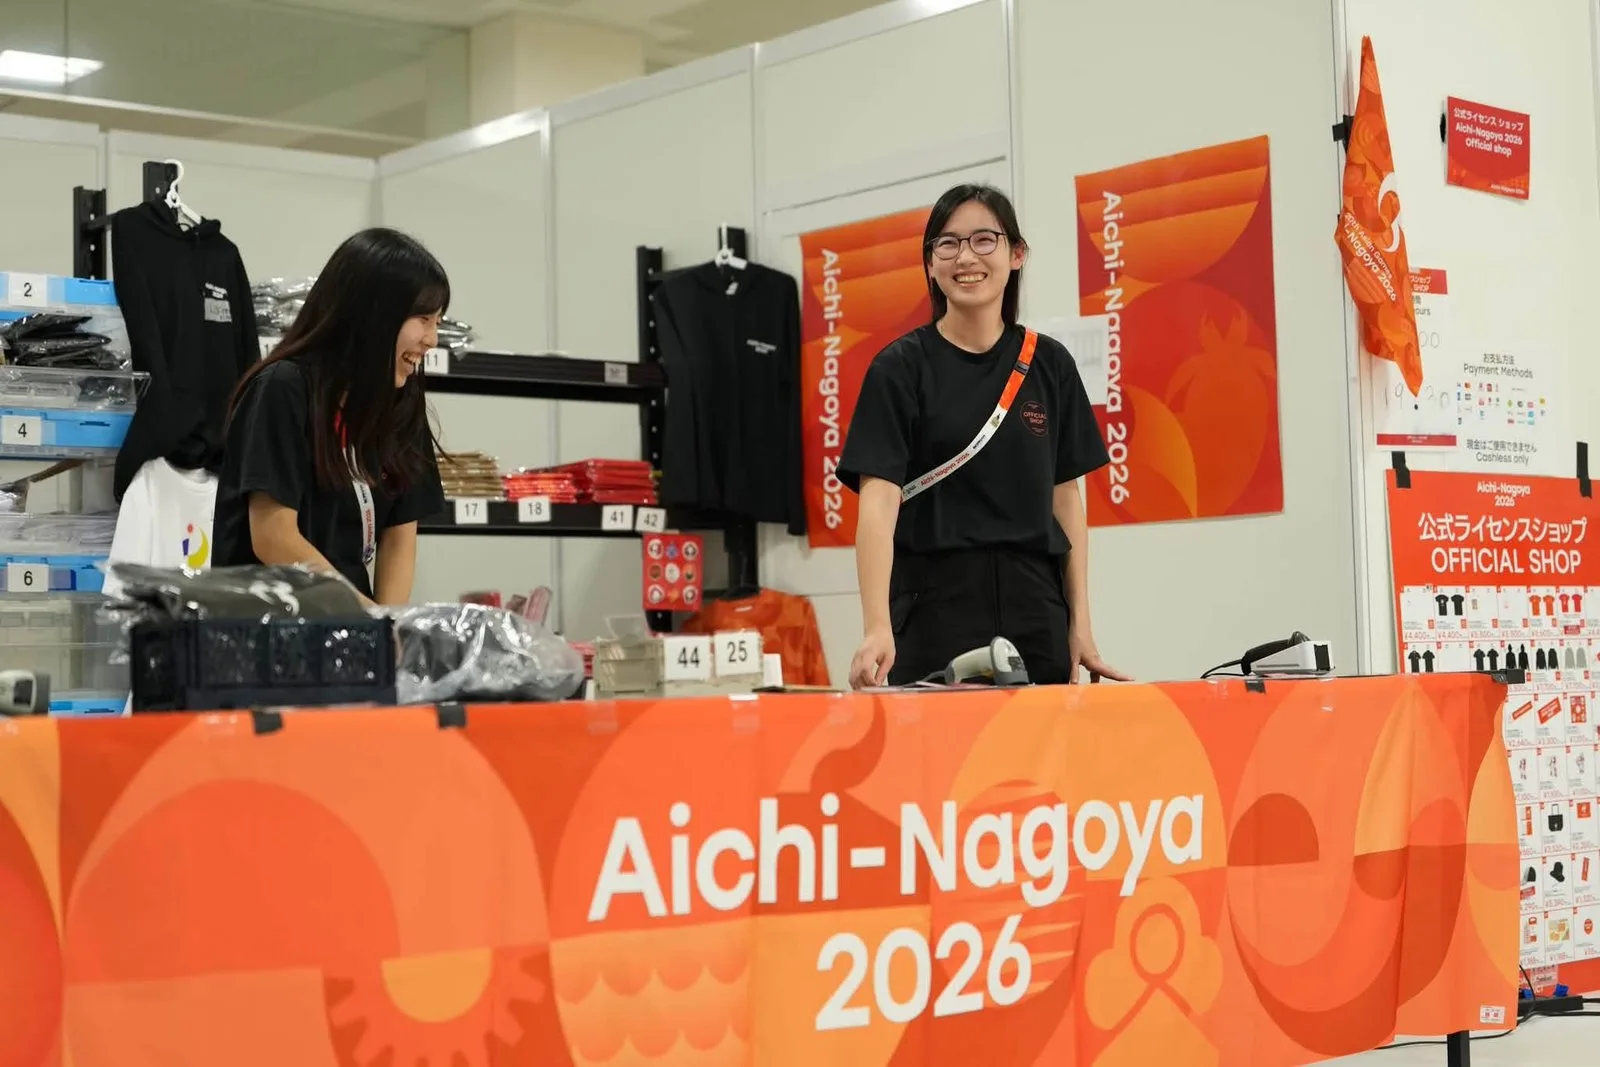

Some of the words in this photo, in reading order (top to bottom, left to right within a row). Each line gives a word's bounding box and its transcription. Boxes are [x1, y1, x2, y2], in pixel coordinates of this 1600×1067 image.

[1456, 122, 1503, 144] Aichi-Nagoya
[1504, 133, 1523, 145] 2026
[1465, 138, 1492, 151] Official
[1494, 144, 1512, 158] shop
[1359, 231, 1375, 252] Asian
[1374, 251, 1393, 280] Games
[23, 282, 32, 297] 2
[1377, 272, 1397, 301] 2026
[1102, 191, 1125, 414] Aichi-Nagoya
[819, 248, 843, 448] Aichi-Nagoya
[1464, 363, 1499, 376] Payment
[1501, 366, 1533, 379] Methods
[1023, 411, 1047, 420] OFFICIAL
[17, 423, 28, 438] 4
[1106, 421, 1130, 505] 2026
[1476, 451, 1512, 463] Cashless
[1513, 454, 1529, 466] only
[823, 455, 843, 530] 2026
[1476, 481, 1531, 497] Aichi-Nagoya
[464, 503, 478, 517] 17
[527, 502, 542, 516] 18
[1494, 495, 1516, 507] 2026
[610, 511, 625, 524] 41
[643, 513, 658, 527] 42
[1418, 512, 1588, 544] 公式ライセンスショップ
[1431, 546, 1525, 574] OFFICIAL
[1529, 548, 1582, 574] SHOP
[23, 571, 33, 587] 6
[678, 646, 700, 668] 44
[727, 640, 748, 662] 25
[587, 792, 1205, 922] Aichi-Nagoya
[815, 914, 1032, 1031] 2026
